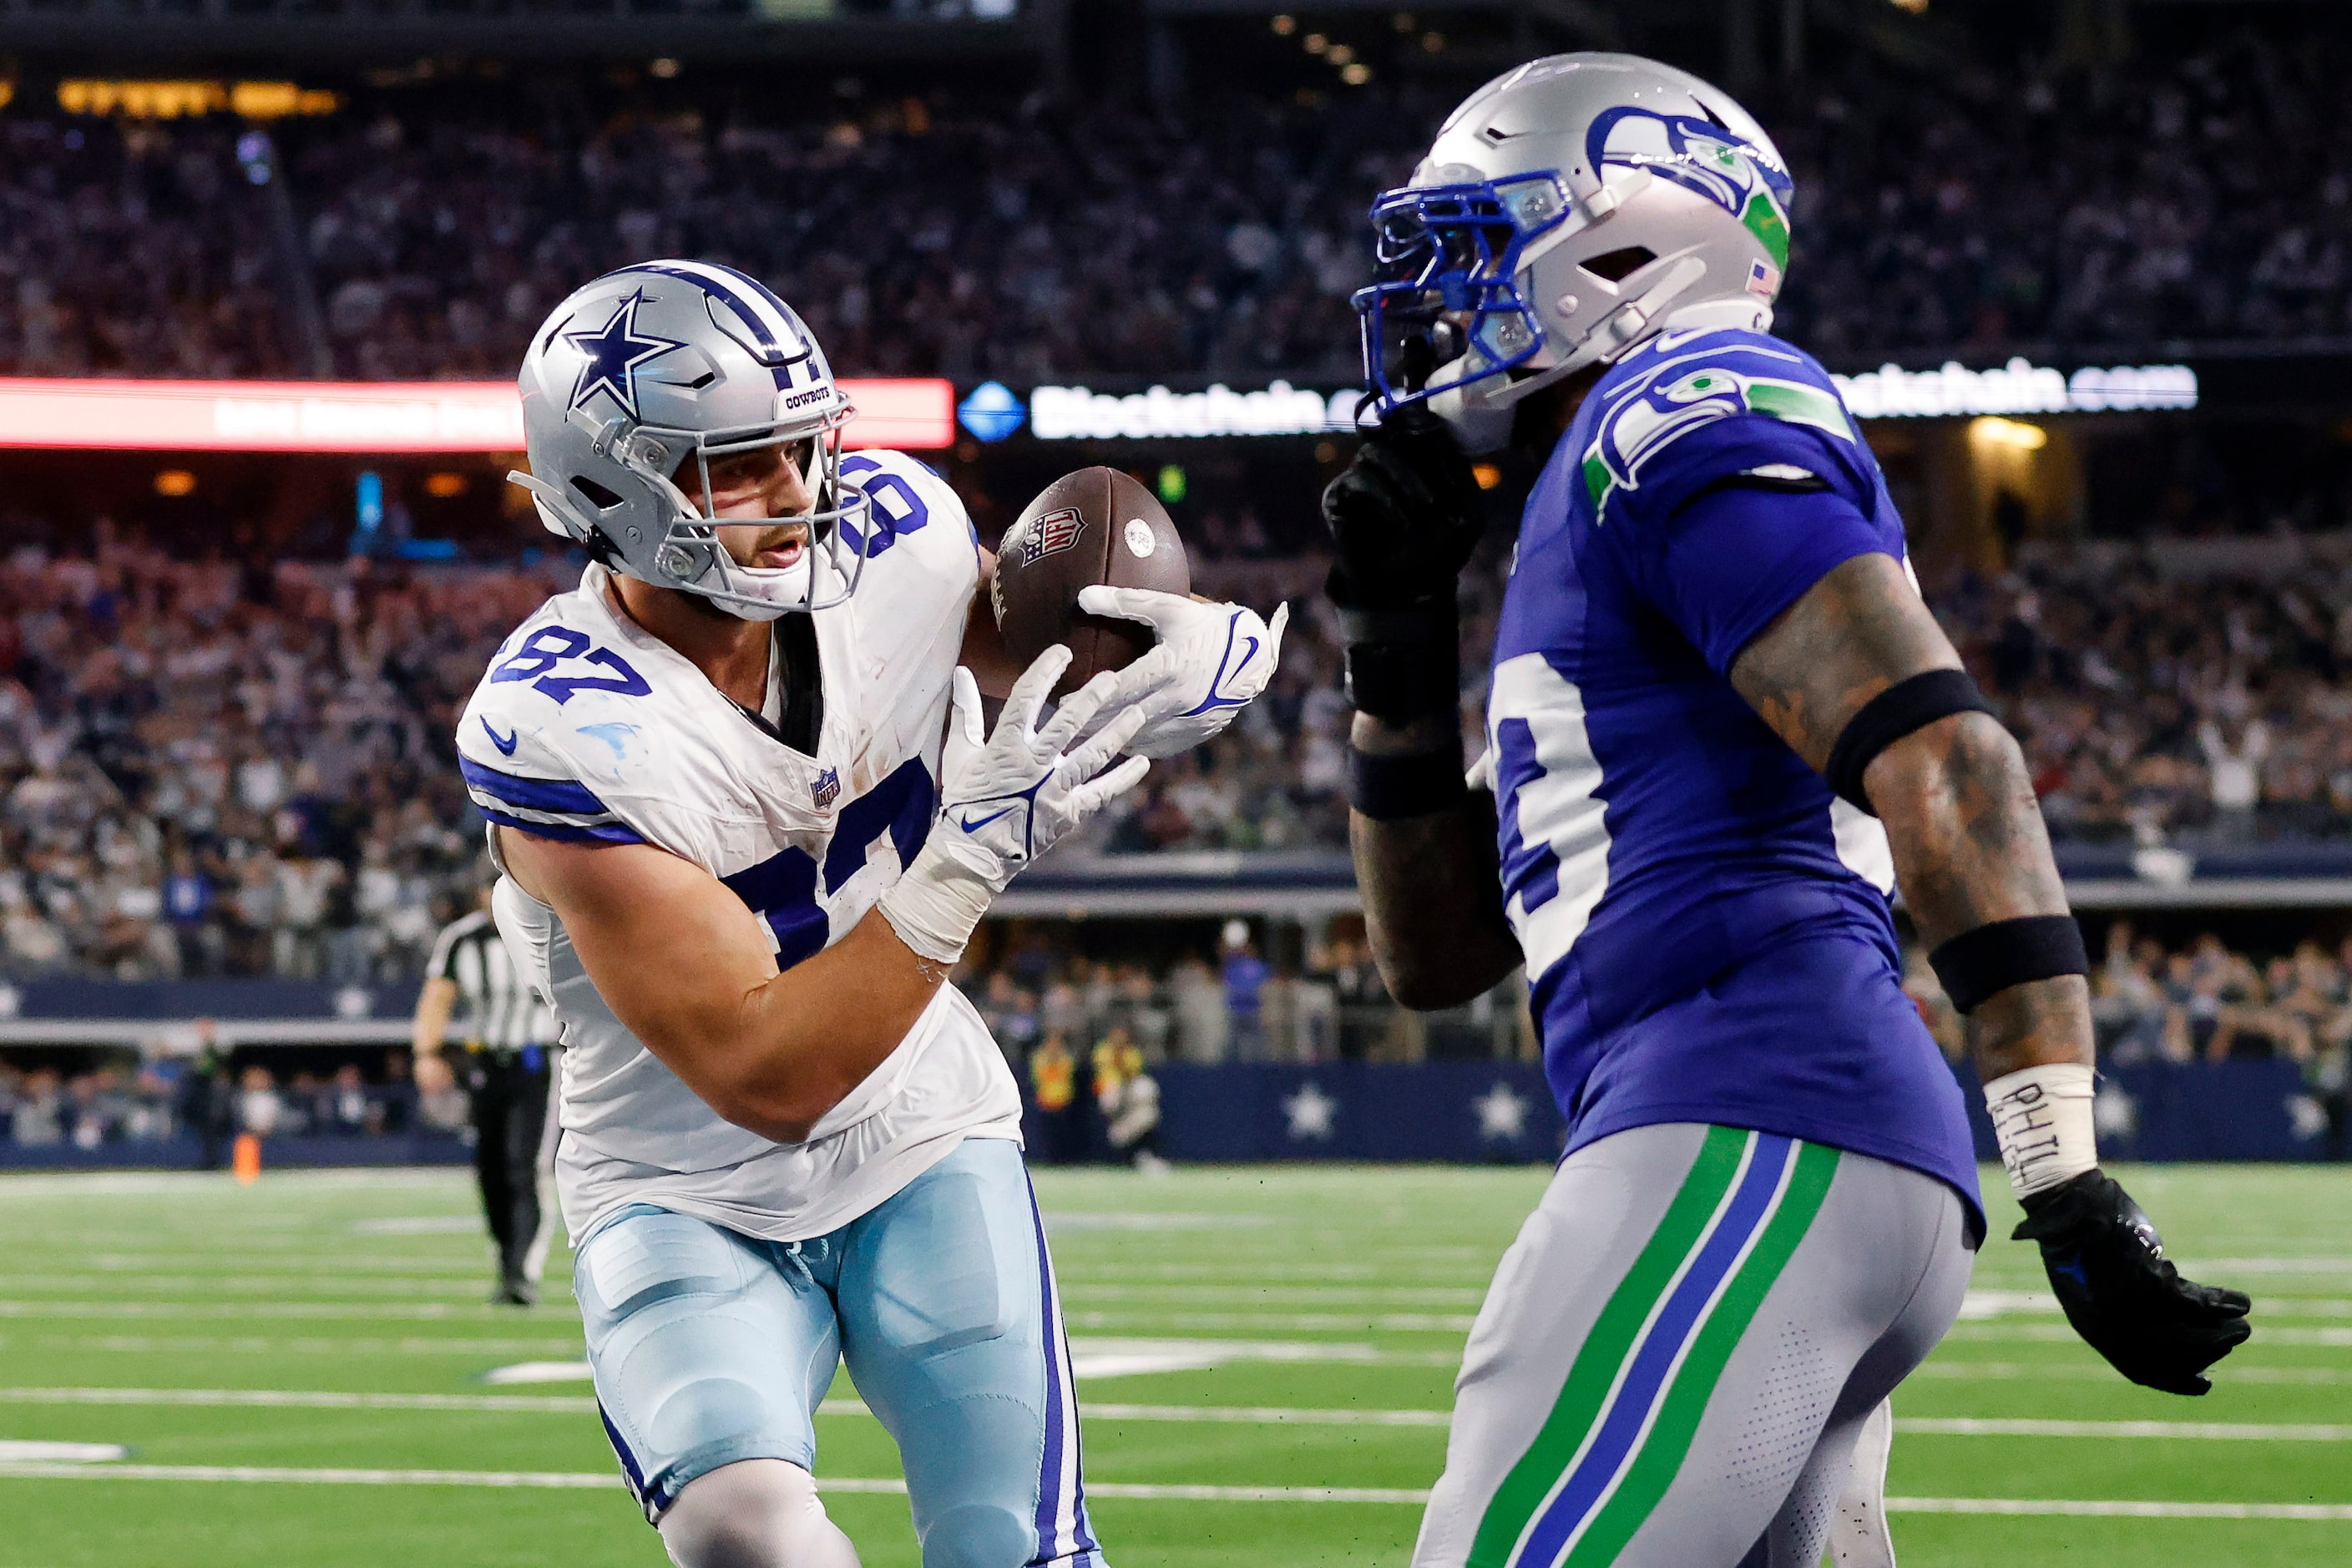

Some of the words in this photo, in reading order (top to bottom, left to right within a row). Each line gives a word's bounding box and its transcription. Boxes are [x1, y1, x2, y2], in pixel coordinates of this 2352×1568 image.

[786, 387, 830, 409] COWBOYS
[1044, 511, 1077, 551] NFL
[490, 625, 653, 705] 87
[1474, 652, 1612, 984] 3
